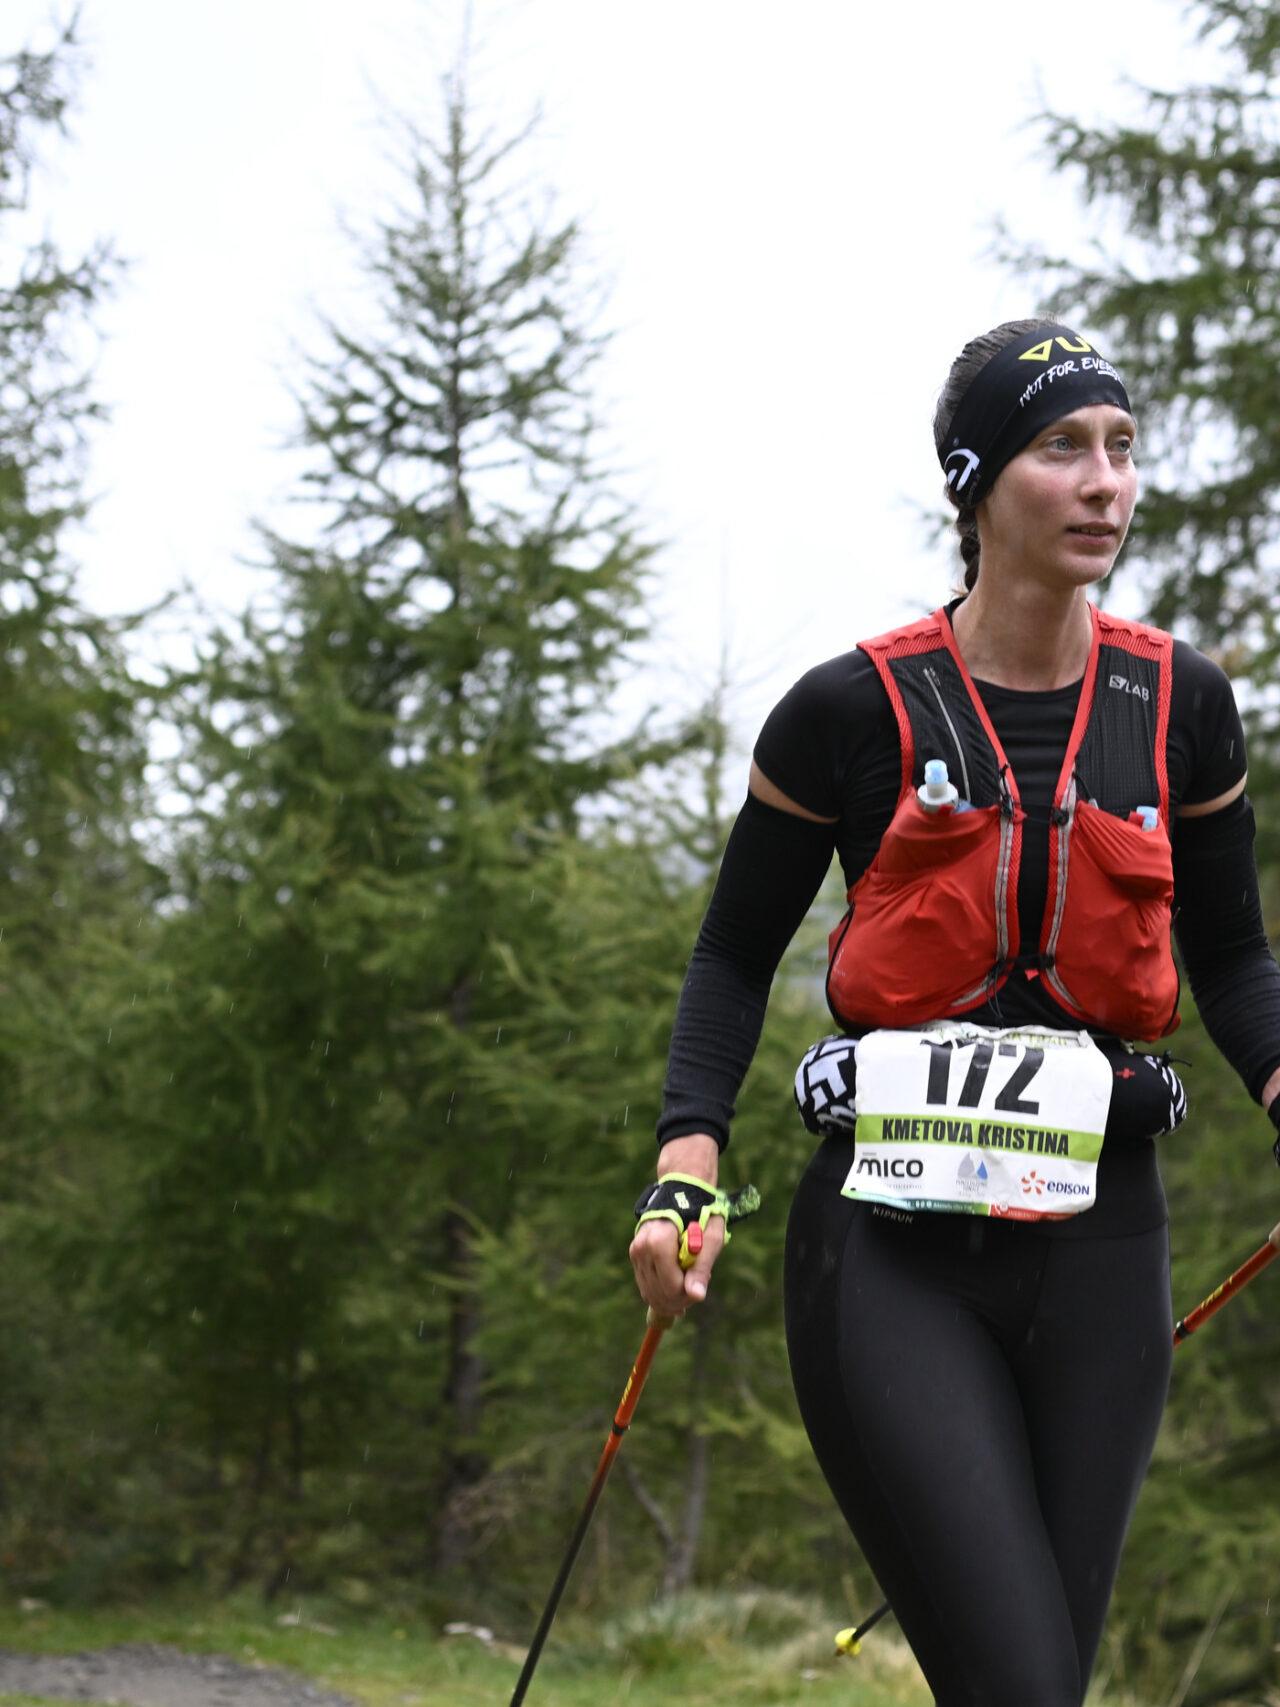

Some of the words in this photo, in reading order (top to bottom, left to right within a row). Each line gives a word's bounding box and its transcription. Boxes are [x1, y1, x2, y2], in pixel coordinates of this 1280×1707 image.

[1019, 372, 1045, 408] NOT
[1046, 360, 1079, 383] FOR
[919, 1038, 1045, 1116] 172
[882, 1118, 974, 1144] KMETOVA
[977, 1123, 1070, 1156] KRISTINA
[872, 1205, 915, 1224] KIPRUN
